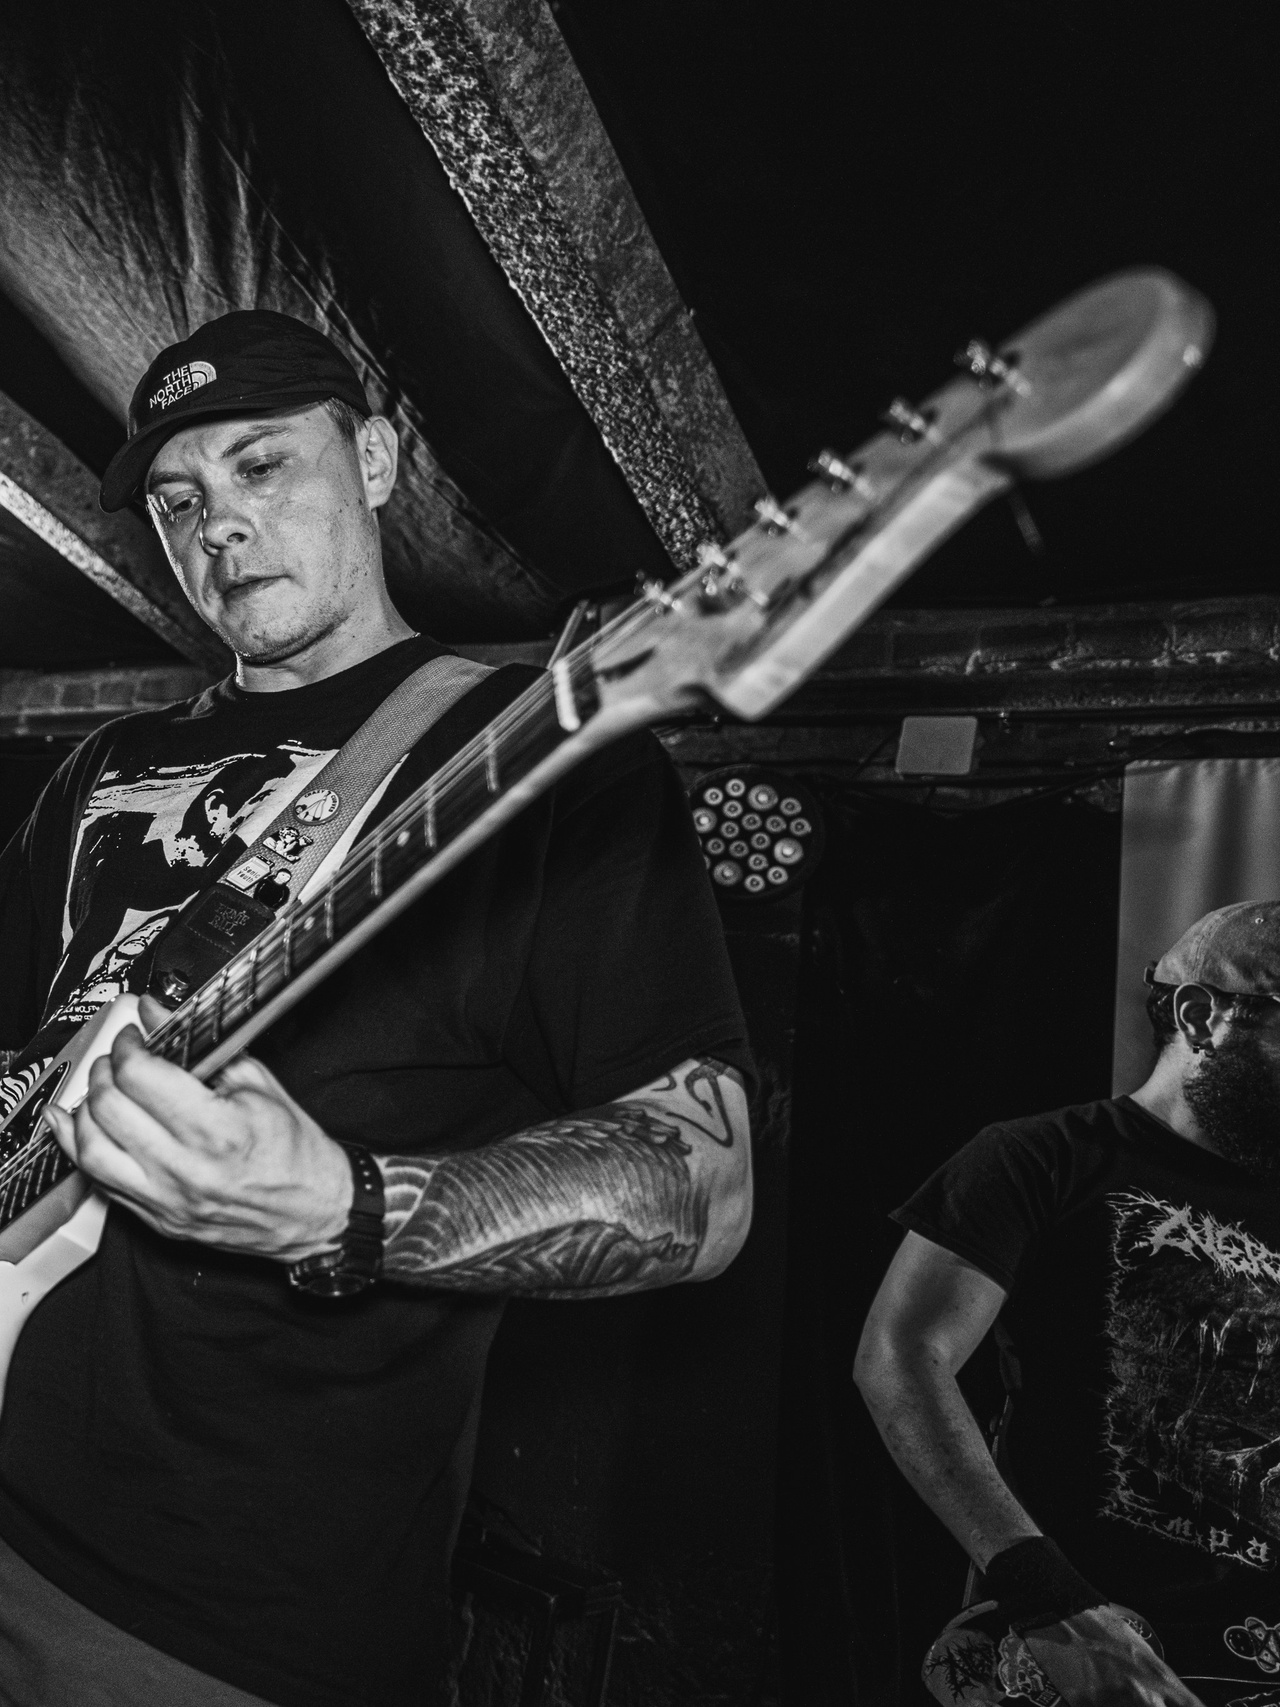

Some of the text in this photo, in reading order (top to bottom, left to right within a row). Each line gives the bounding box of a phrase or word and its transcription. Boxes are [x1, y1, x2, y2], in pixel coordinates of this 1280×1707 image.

[163, 365, 190, 384] THE
[149, 374, 192, 409] NORTH
[161, 384, 193, 410] FACE
